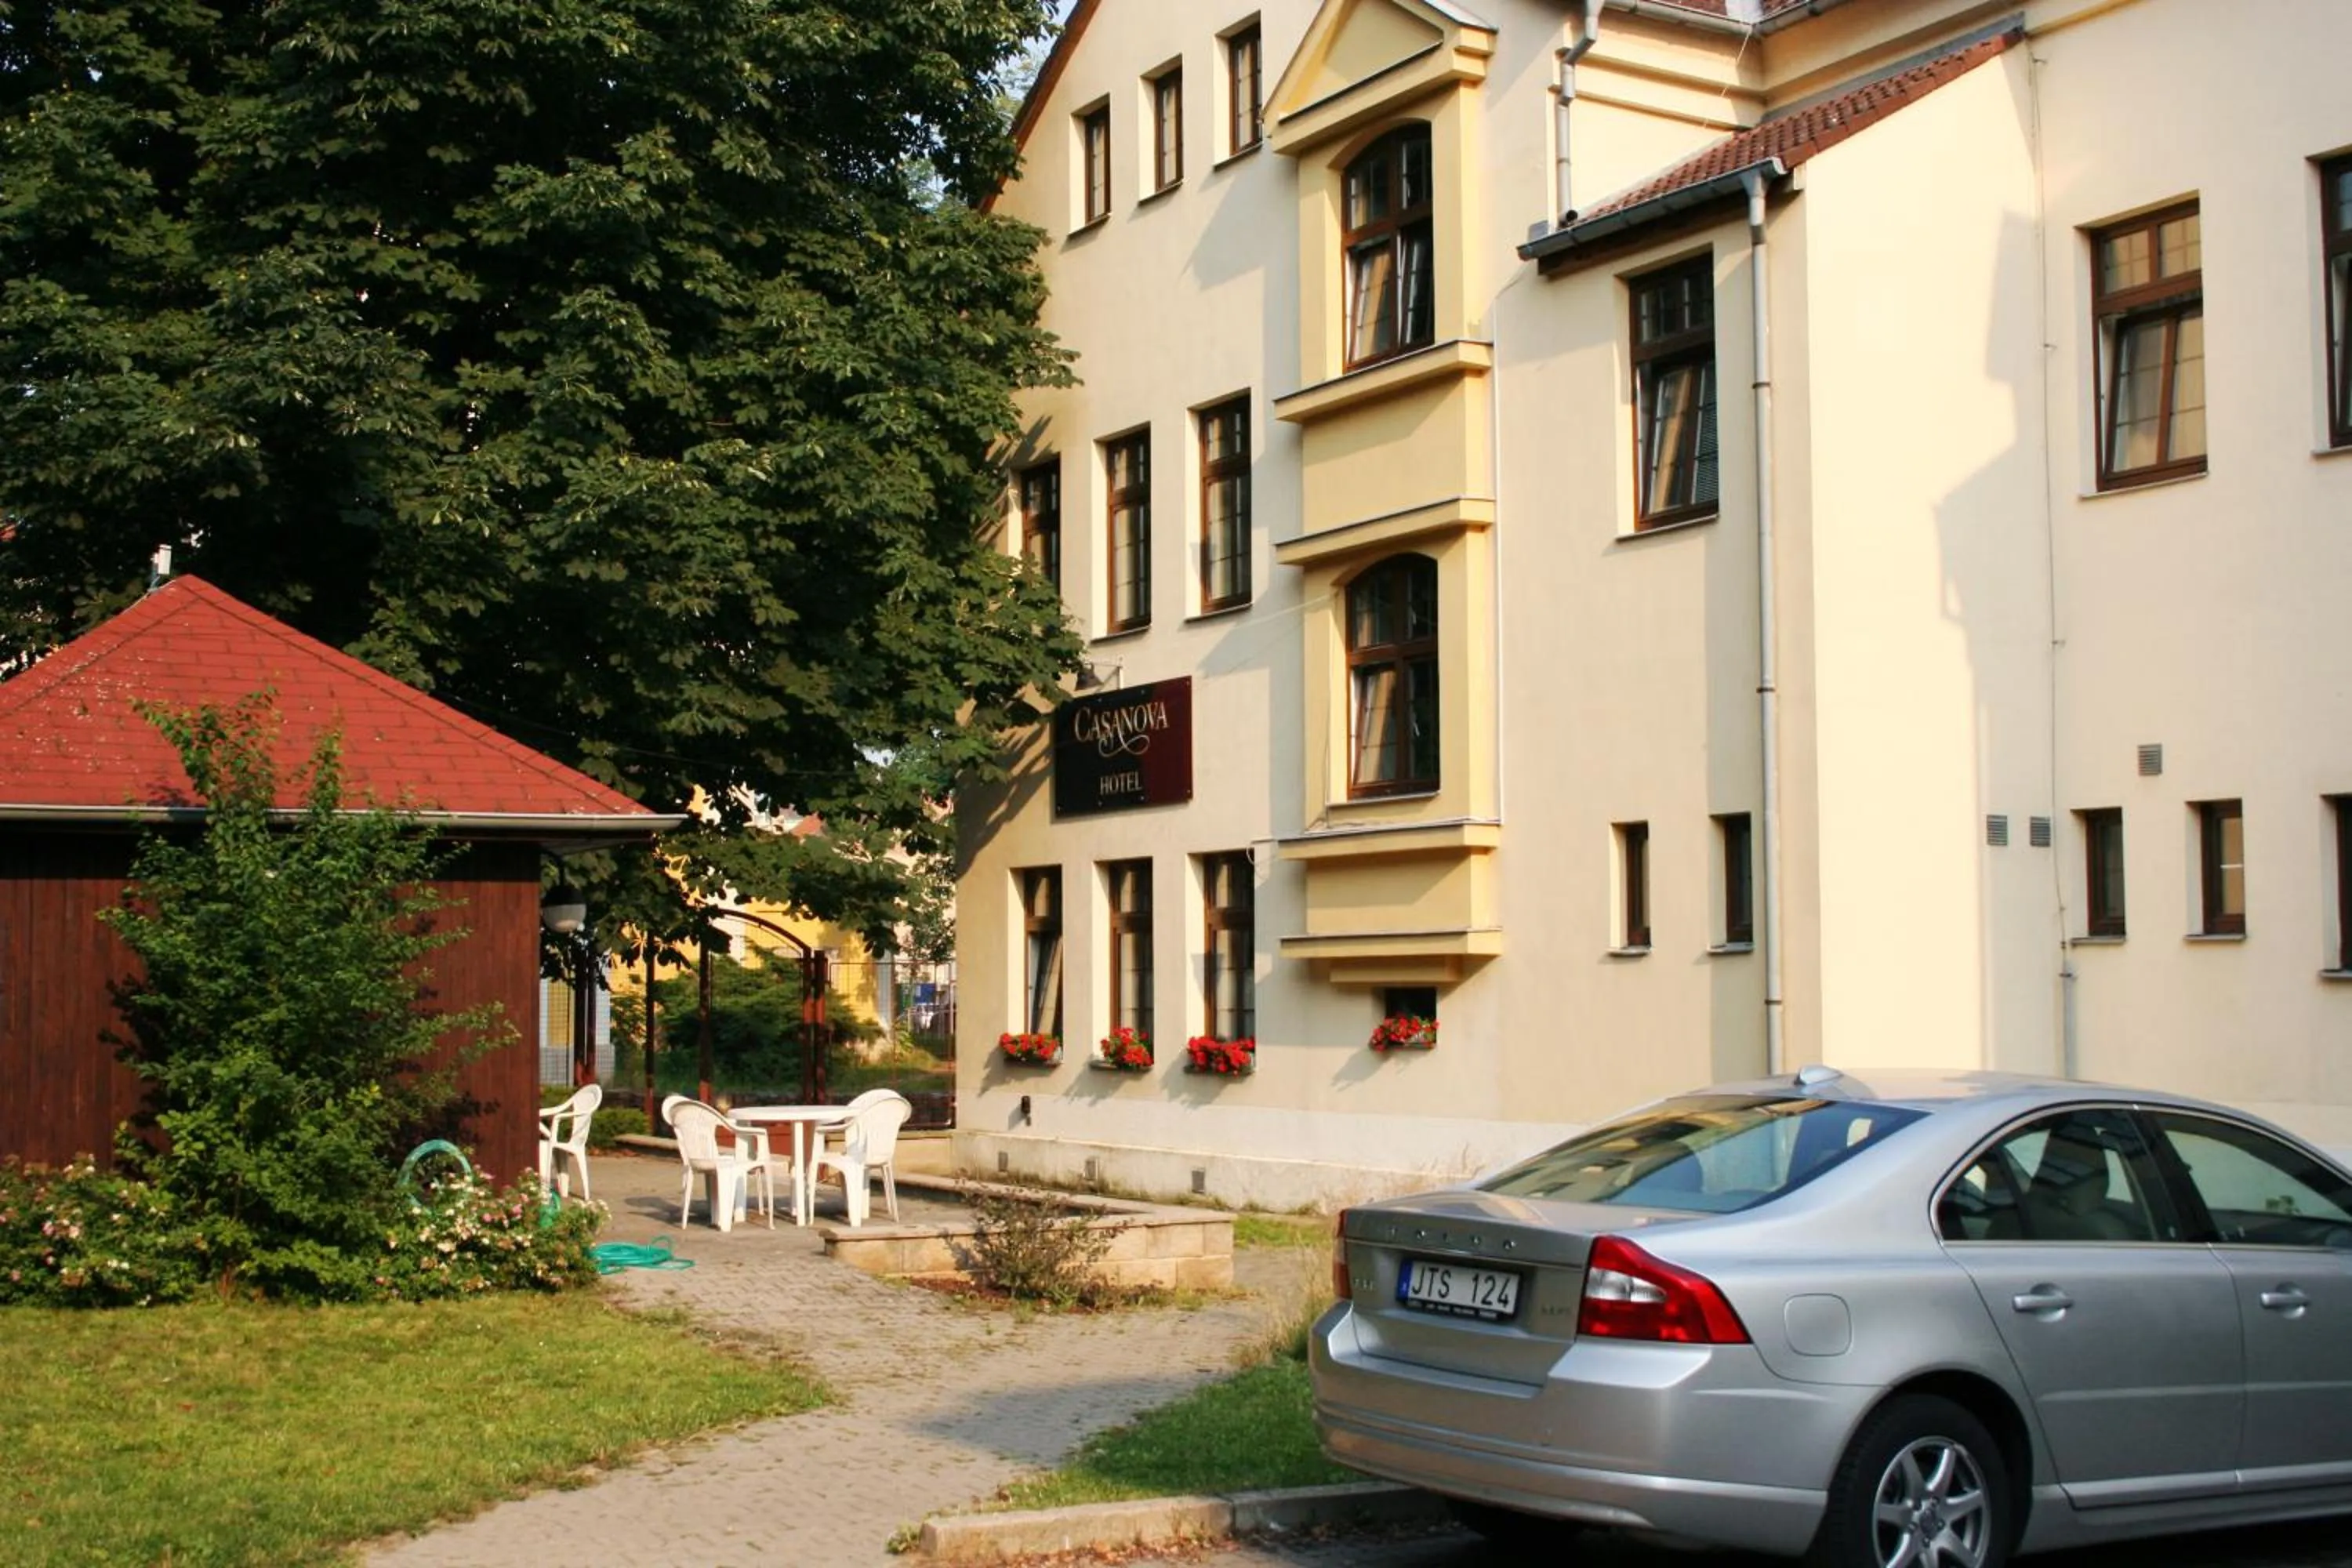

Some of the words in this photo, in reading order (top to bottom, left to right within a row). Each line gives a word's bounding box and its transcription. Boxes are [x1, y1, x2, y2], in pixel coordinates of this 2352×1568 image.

[1075, 702, 1170, 757] CASANOVA
[1100, 771, 1143, 796] HOTEL
[1412, 1265, 1451, 1298] JTS
[1472, 1272, 1511, 1308] 124
